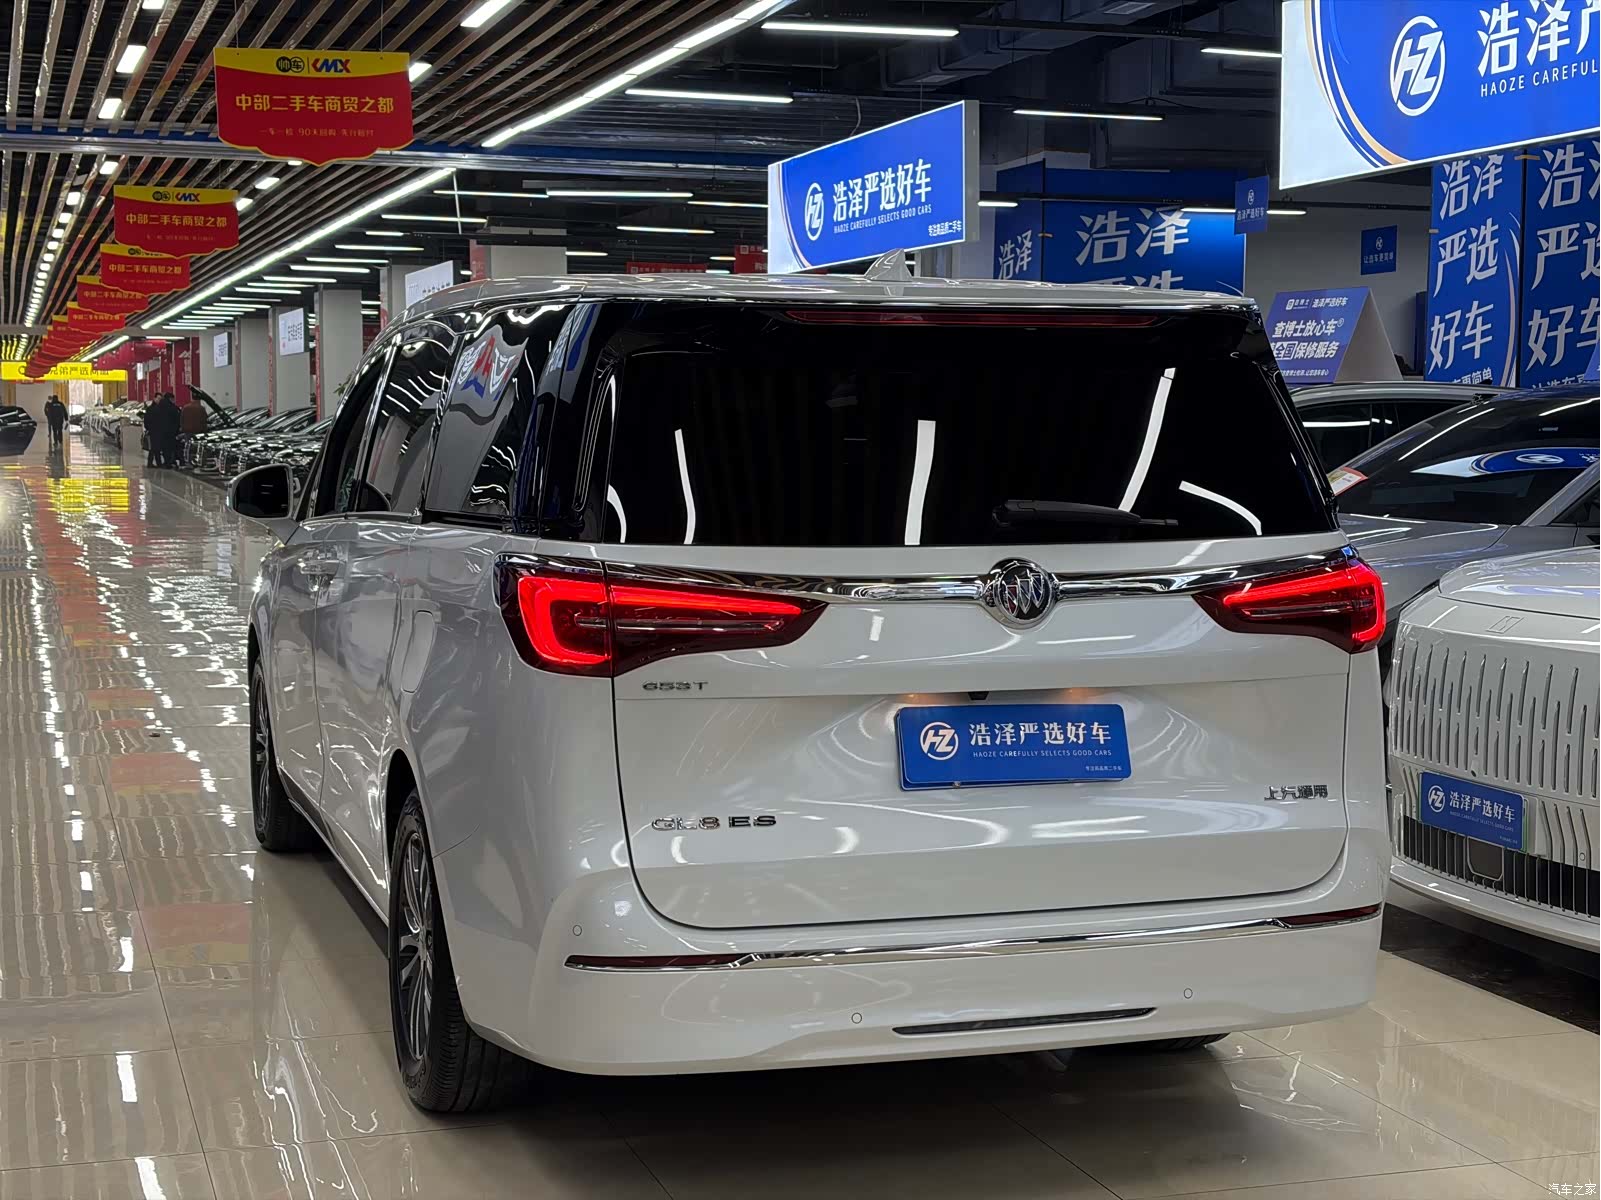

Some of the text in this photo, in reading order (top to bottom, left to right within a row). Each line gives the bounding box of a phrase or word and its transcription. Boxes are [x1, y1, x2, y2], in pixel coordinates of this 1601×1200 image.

[1477, 0, 1600, 77] 浩泽
[1480, 75, 1525, 98] HAOZE
[235, 94, 395, 114] 中部二手车商贸之都
[833, 158, 932, 222] 浩泽严选好车
[1439, 154, 1504, 221] 浩泽
[125, 213, 228, 228] 中部二手车商贸之都
[833, 204, 932, 234] HAOZE CAREFULLY SELECTS GOOD CARS
[1075, 207, 1190, 266] 浩泽
[998, 229, 1032, 280] 浩泽
[1433, 217, 1499, 298] 严选
[1427, 300, 1494, 375] 好车
[642, 681, 709, 691] 653T
[969, 722, 1112, 746] 浩泽严选好车
[1072, 749, 1092, 757] GOOD
[1264, 784, 1328, 801] 上汽通用
[1449, 791, 1515, 823] 浩泽严选好车
[651, 815, 777, 831] GL8 ES
